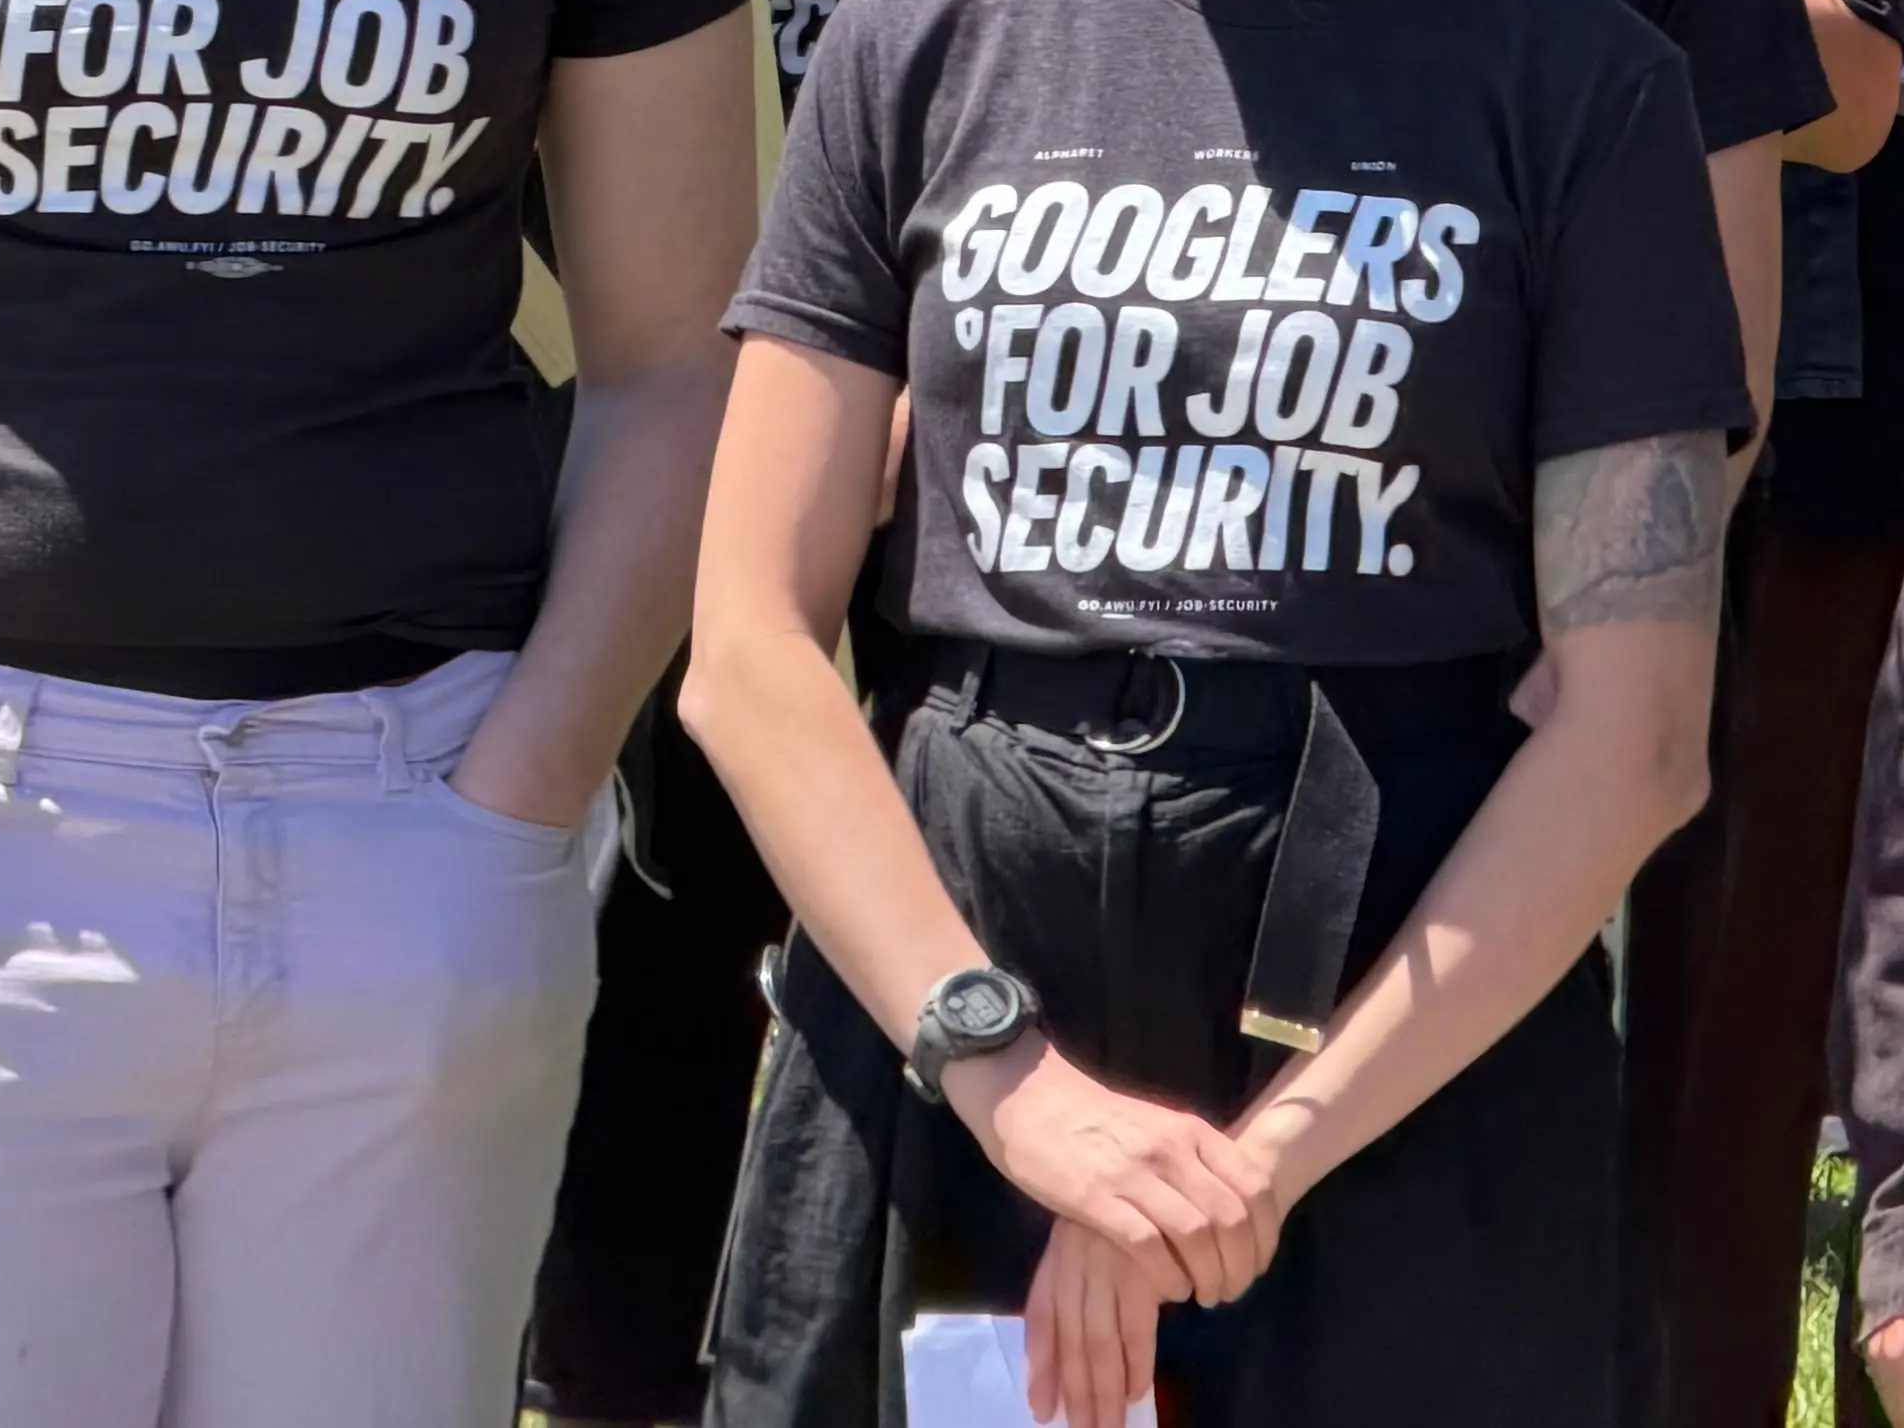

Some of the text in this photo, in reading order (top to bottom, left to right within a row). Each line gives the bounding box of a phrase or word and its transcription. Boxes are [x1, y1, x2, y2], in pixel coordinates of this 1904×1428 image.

[941, 181, 1481, 324] GOOGLERS
[980, 302, 1414, 449] FOR JOB
[962, 441, 1421, 577] SECURITY.
